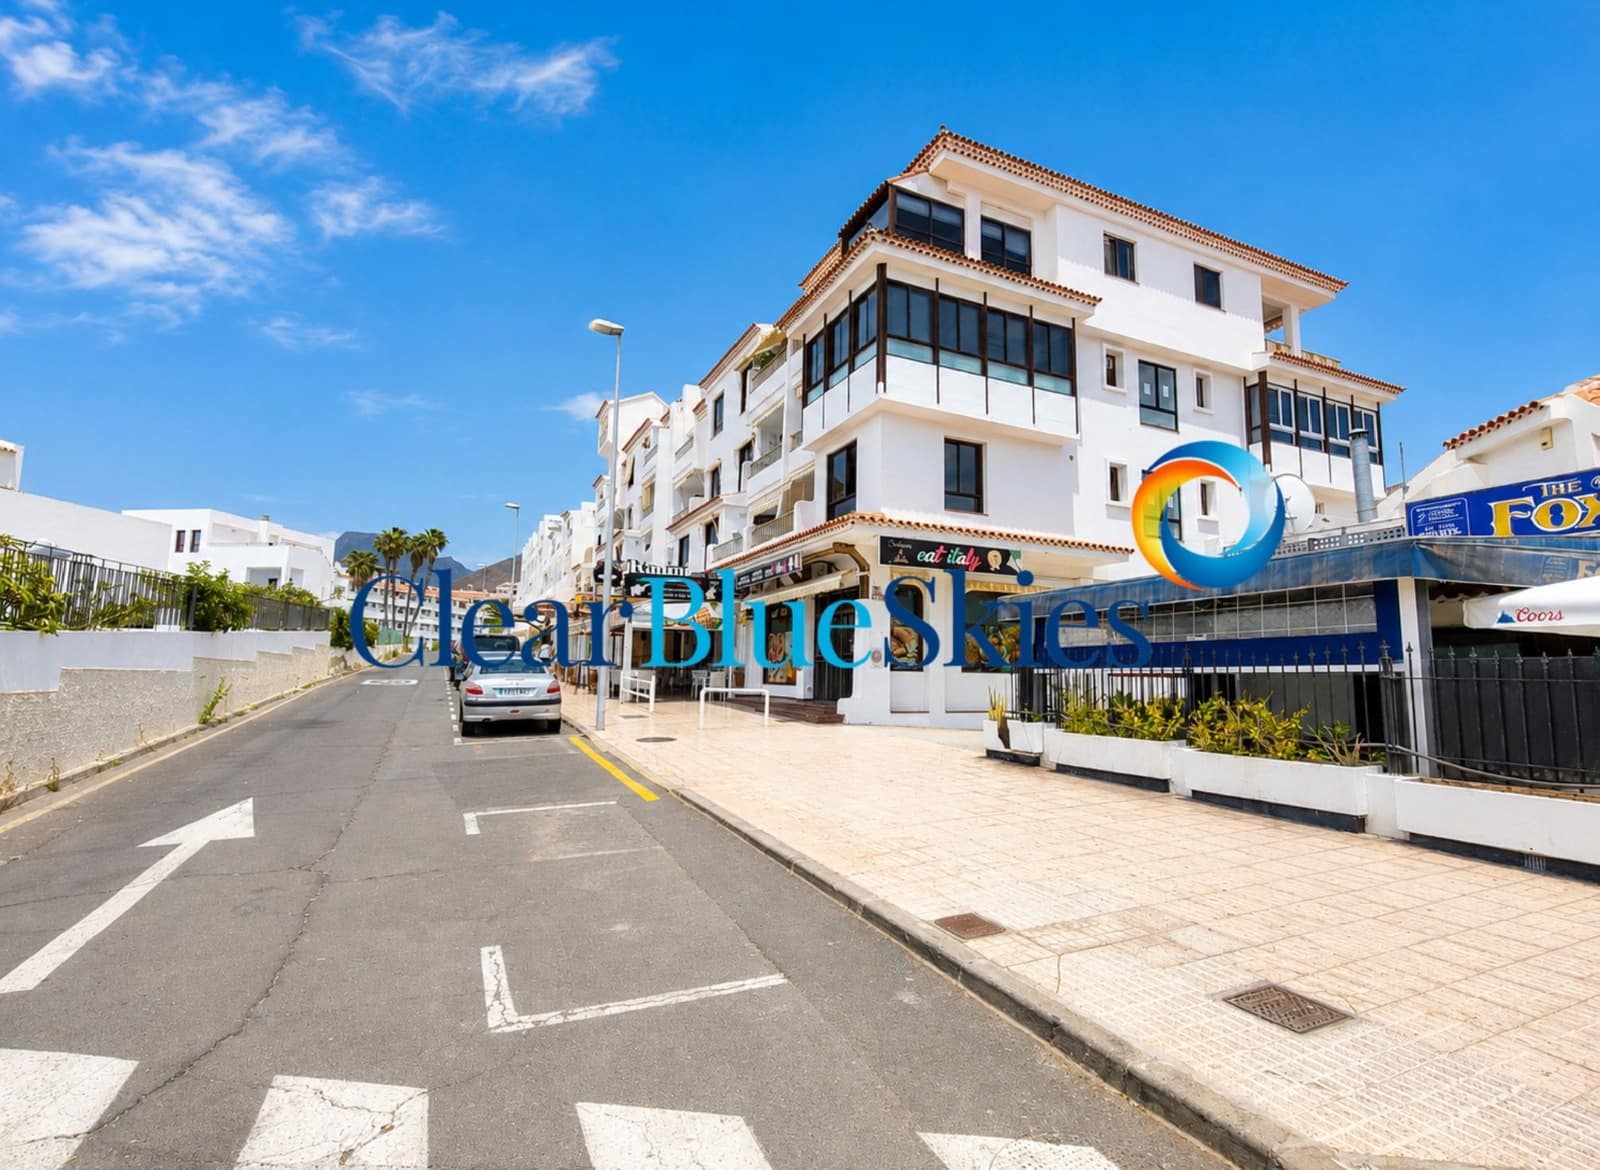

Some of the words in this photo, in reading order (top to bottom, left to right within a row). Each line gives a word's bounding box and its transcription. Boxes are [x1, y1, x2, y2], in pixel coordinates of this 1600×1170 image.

[1522, 478, 1583, 497] THE
[916, 545, 947, 564] eat
[946, 546, 982, 572] italy
[1515, 607, 1564, 622] Coors
